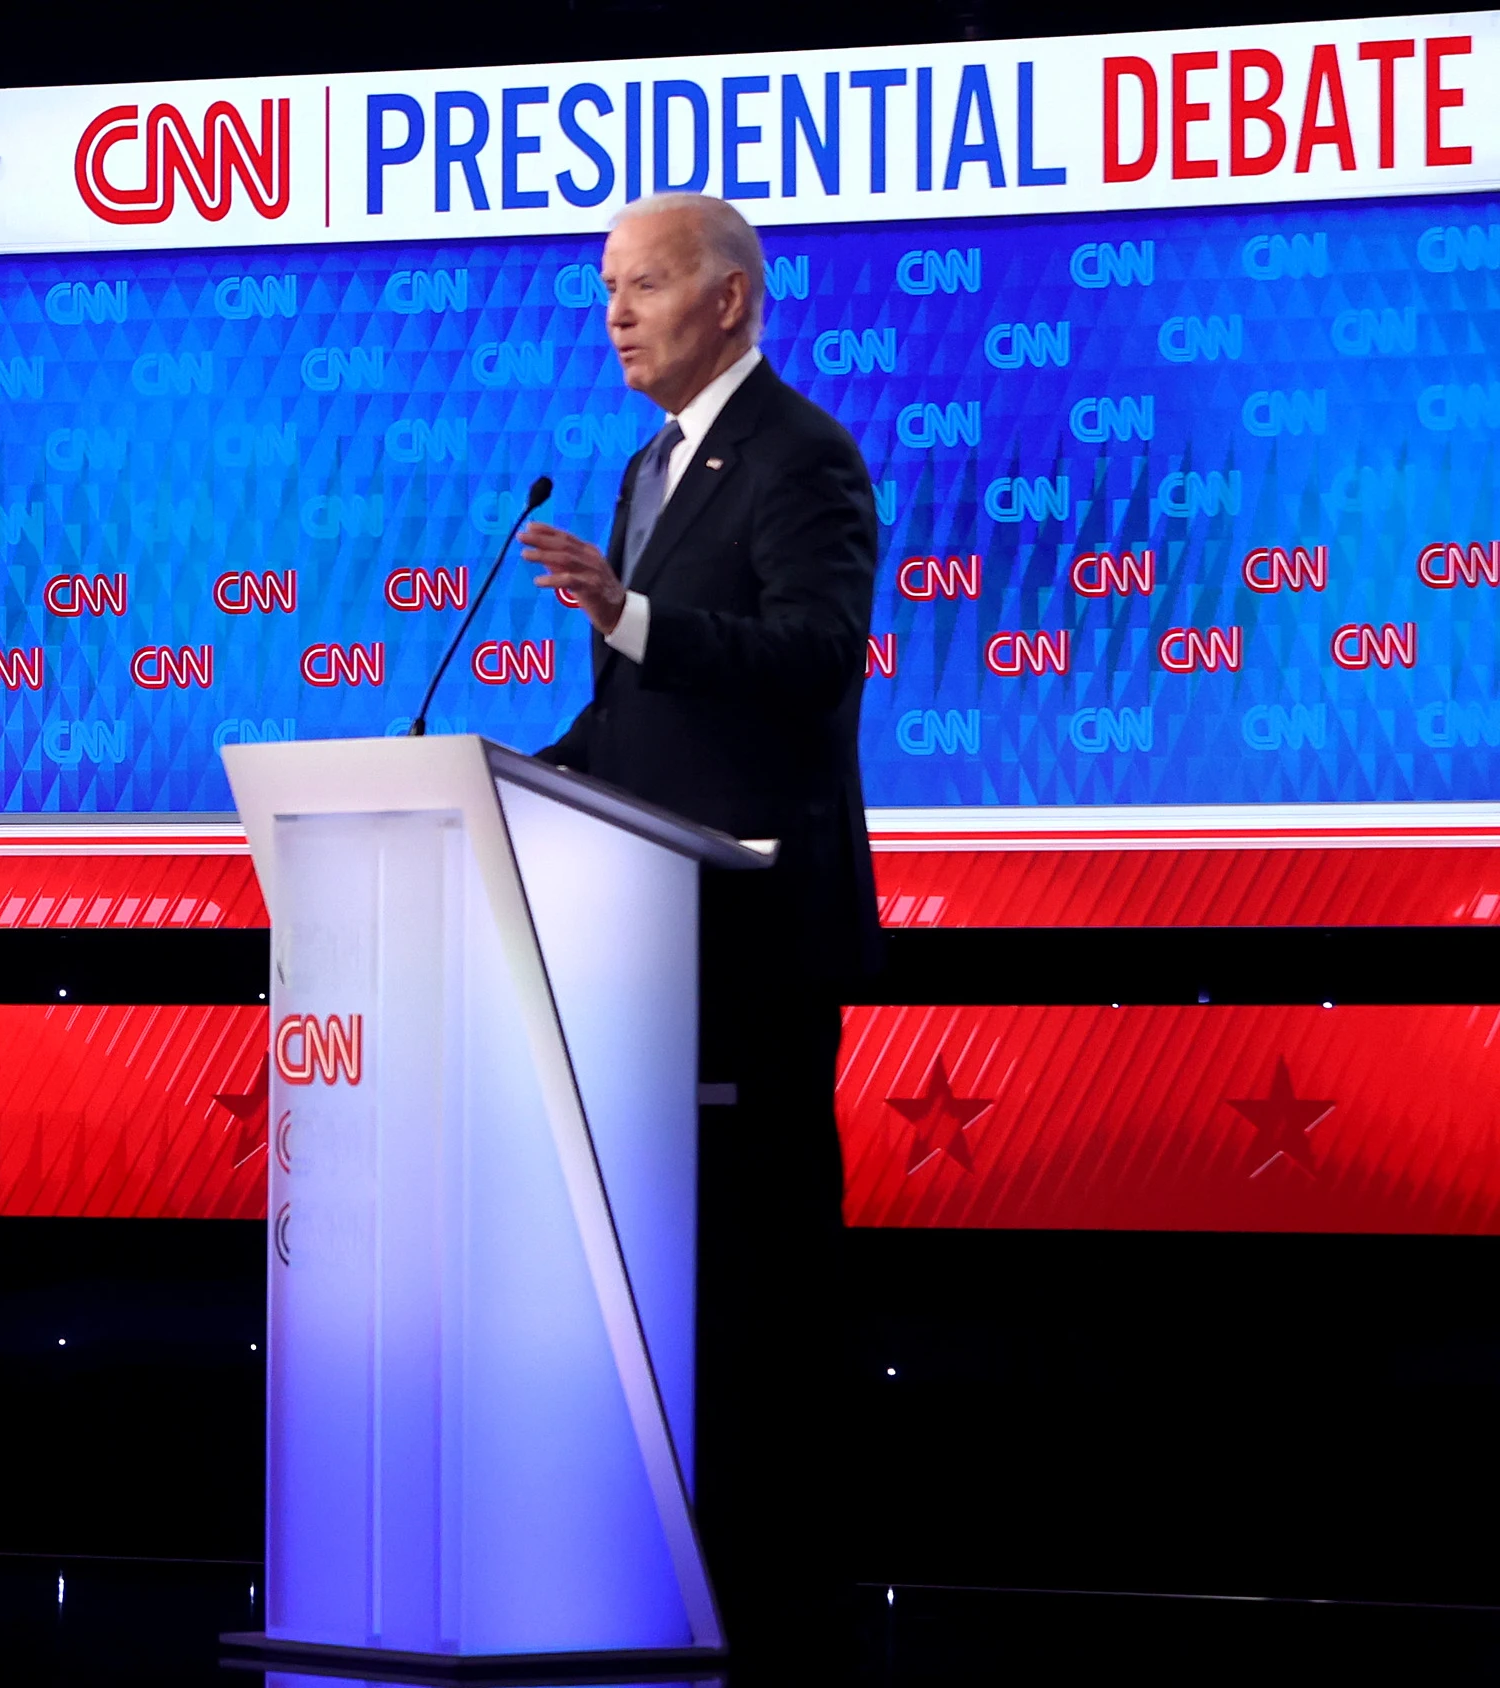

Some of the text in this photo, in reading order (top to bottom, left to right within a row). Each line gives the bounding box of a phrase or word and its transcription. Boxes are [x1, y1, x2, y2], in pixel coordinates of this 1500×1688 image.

[74, 36, 1472, 225] CNN PRESIDENTIAL DEBATE
[896, 248, 981, 295] CNN
[1070, 241, 1153, 288] CNN
[1242, 233, 1327, 280] CNN
[1417, 226, 1500, 273] CNN
[45, 281, 128, 323] CNN
[214, 275, 296, 319] CNN
[385, 269, 467, 313] CNN
[813, 328, 896, 375] CNN
[984, 321, 1069, 368] CNN
[1157, 314, 1241, 362] CNN
[1331, 307, 1415, 354] CNN
[131, 352, 213, 395] CNN
[302, 346, 383, 391] CNN
[472, 341, 554, 386] CNN
[896, 401, 980, 448] CNN
[1070, 395, 1154, 443] CNN
[1242, 390, 1326, 437] CNN
[1417, 384, 1500, 431] CNN
[45, 427, 127, 471] CNN
[214, 421, 297, 466] CNN
[385, 417, 467, 462] CNN
[554, 412, 636, 458] CNN
[302, 495, 384, 538] CNN
[984, 476, 1069, 522] CNN
[1157, 470, 1241, 517] CNN
[898, 554, 981, 601] CNN
[1071, 549, 1154, 597] CNN
[1243, 545, 1327, 593] CNN
[1417, 541, 1500, 588] CNN
[44, 573, 126, 617] CNN
[214, 570, 296, 614] CNN
[384, 566, 466, 611] CNN
[131, 645, 213, 689] CNN
[301, 642, 384, 686] CNN
[471, 639, 554, 685] CNN
[985, 629, 1069, 676] CNN
[1158, 626, 1242, 673] CNN
[1332, 622, 1417, 669] CNN
[43, 720, 126, 764] CNN
[896, 709, 980, 755] CNN
[1070, 706, 1153, 753] CNN
[1242, 704, 1328, 750] CNN
[1417, 701, 1500, 747] CNN
[276, 1014, 361, 1085] CNN
